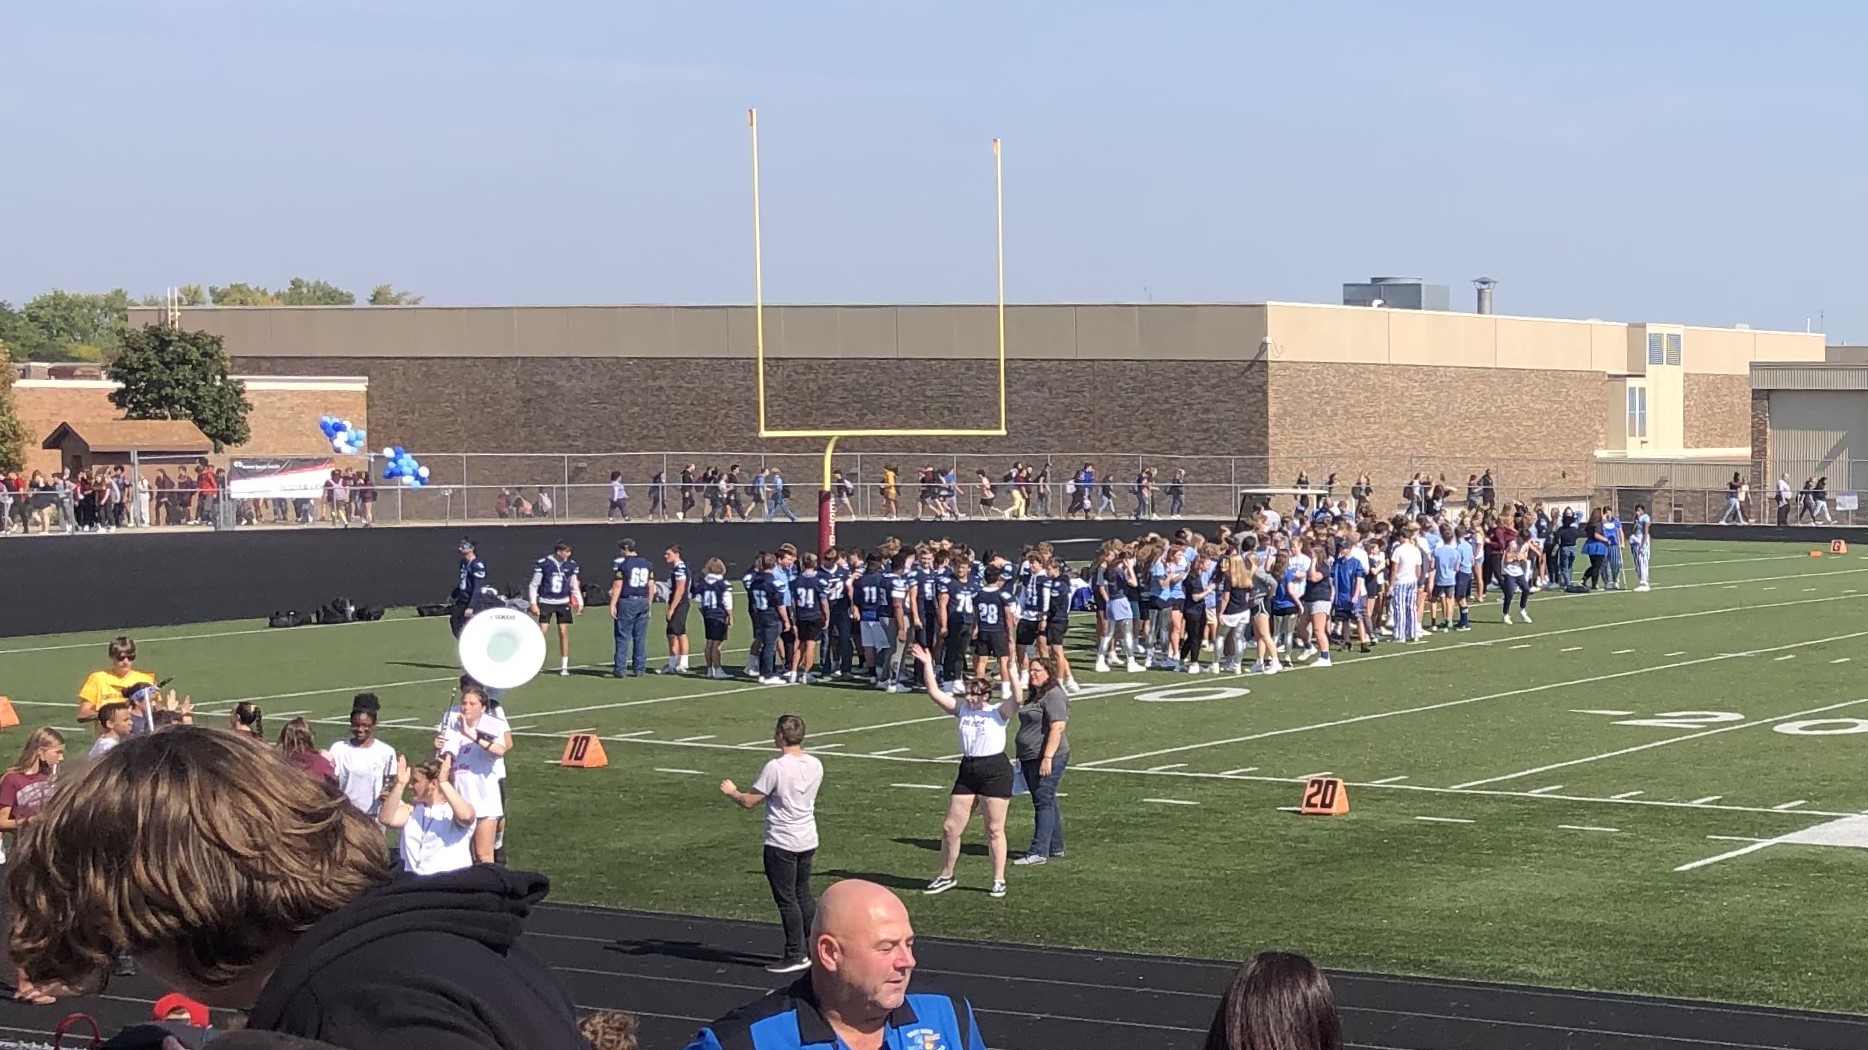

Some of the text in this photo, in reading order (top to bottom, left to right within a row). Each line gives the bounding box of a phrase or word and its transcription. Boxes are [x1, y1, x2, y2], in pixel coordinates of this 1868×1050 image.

[630, 567, 650, 588] 69
[796, 587, 815, 609] 34
[862, 586, 878, 604] 11
[568, 735, 591, 761] 10
[1305, 779, 1339, 809] 20
